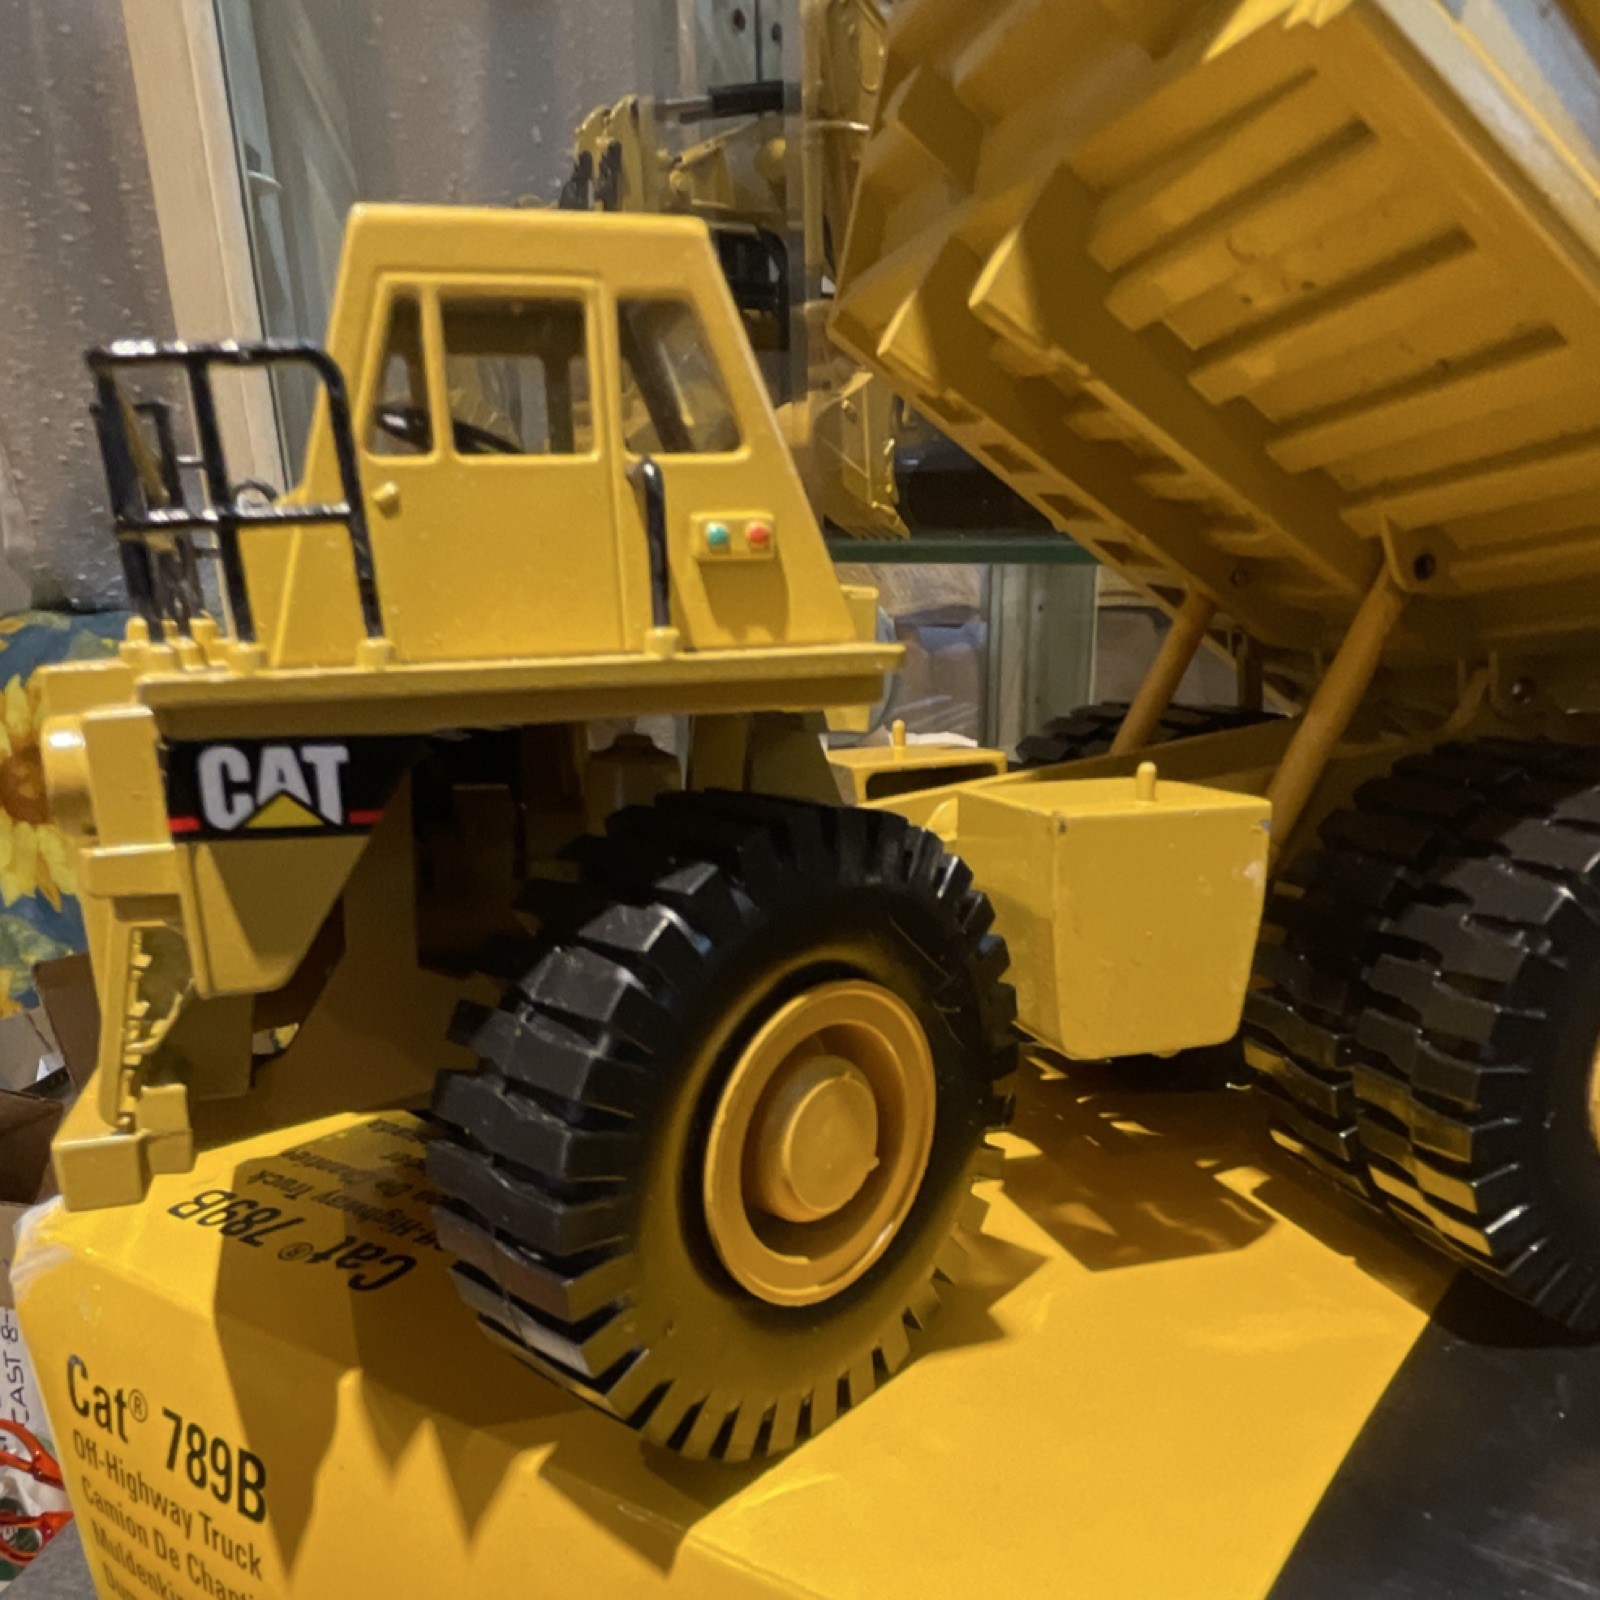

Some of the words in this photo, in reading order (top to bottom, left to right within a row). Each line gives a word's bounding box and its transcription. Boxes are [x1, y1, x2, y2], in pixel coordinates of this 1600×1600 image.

[197, 744, 350, 831] CAT
[167, 1189, 305, 1247] 789B
[72, 1428, 193, 1540] Off-Highway
[198, 1511, 262, 1581] Truck
[161, 1406, 267, 1524] 789B
[81, 1475, 149, 1549] Camion
[152, 1526, 181, 1571] De
